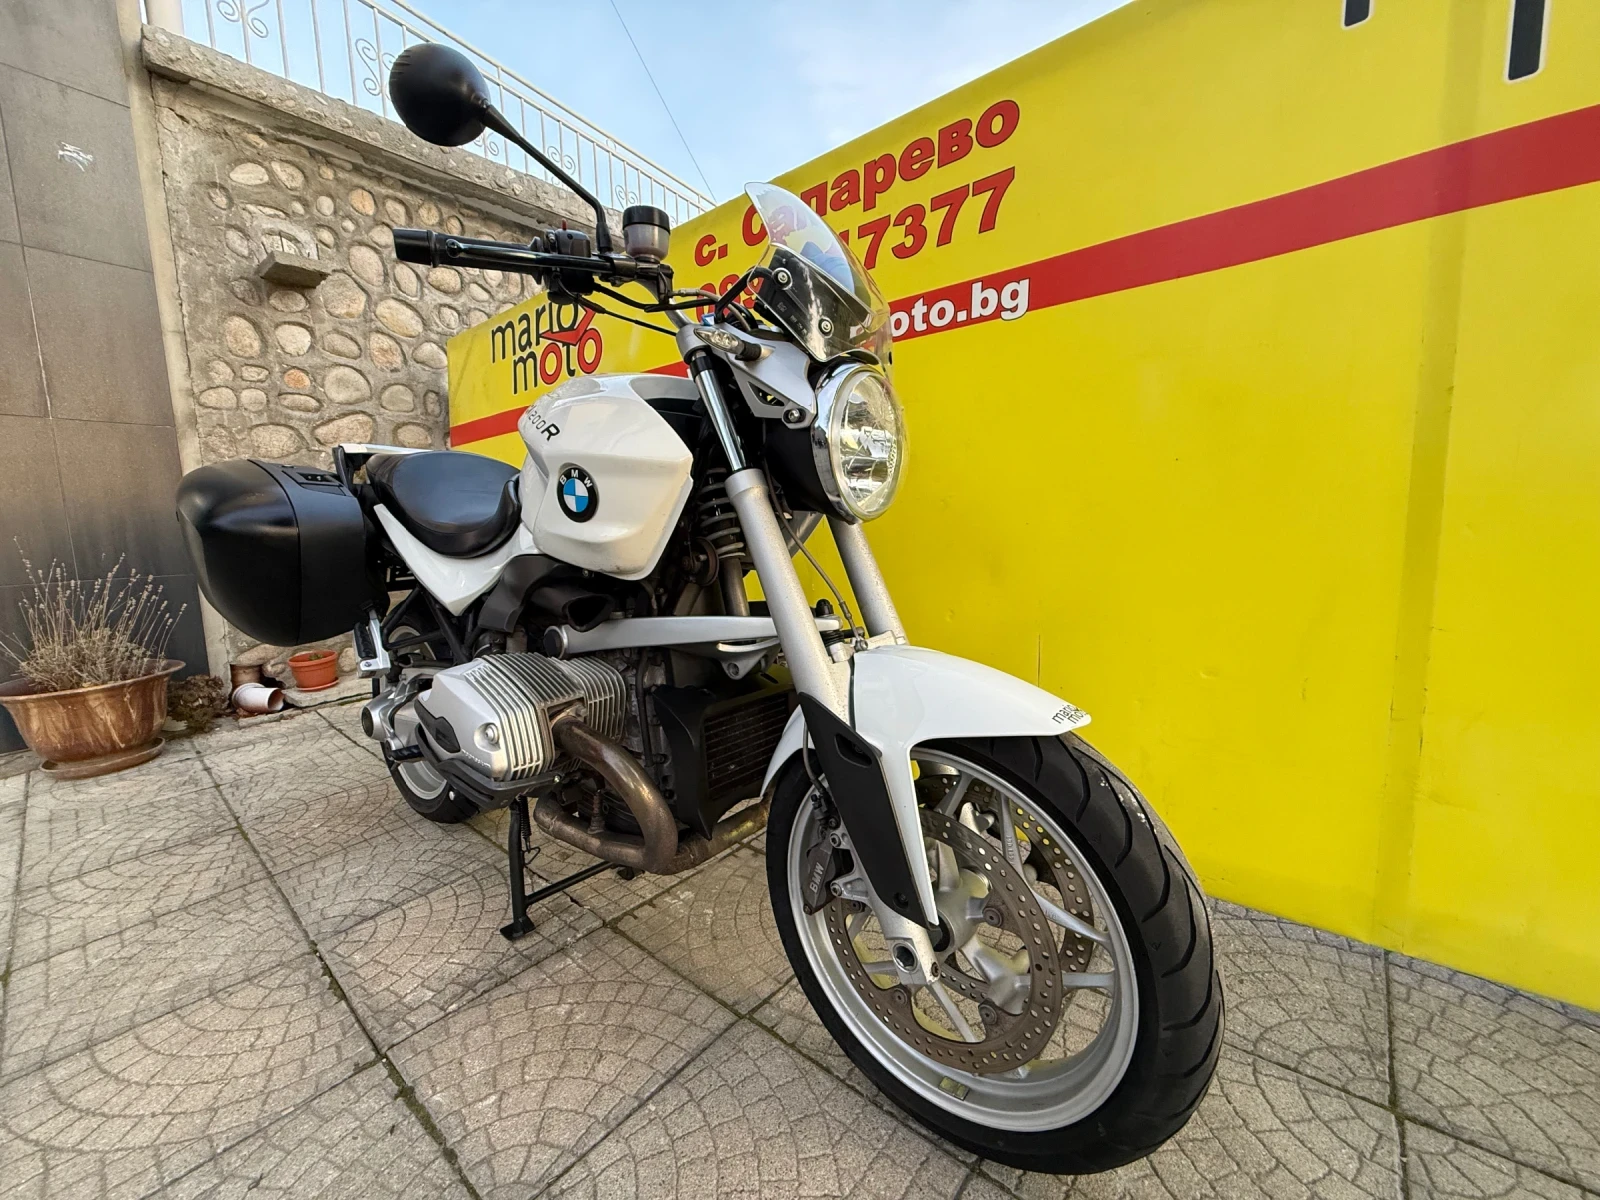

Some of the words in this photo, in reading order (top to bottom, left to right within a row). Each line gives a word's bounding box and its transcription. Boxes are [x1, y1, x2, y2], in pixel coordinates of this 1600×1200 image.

[694, 233, 728, 266] с.
[864, 276, 1031, 330] oto.bg
[491, 301, 578, 364] mario
[559, 469, 593, 488] BMW
[809, 862, 824, 893] BMW
